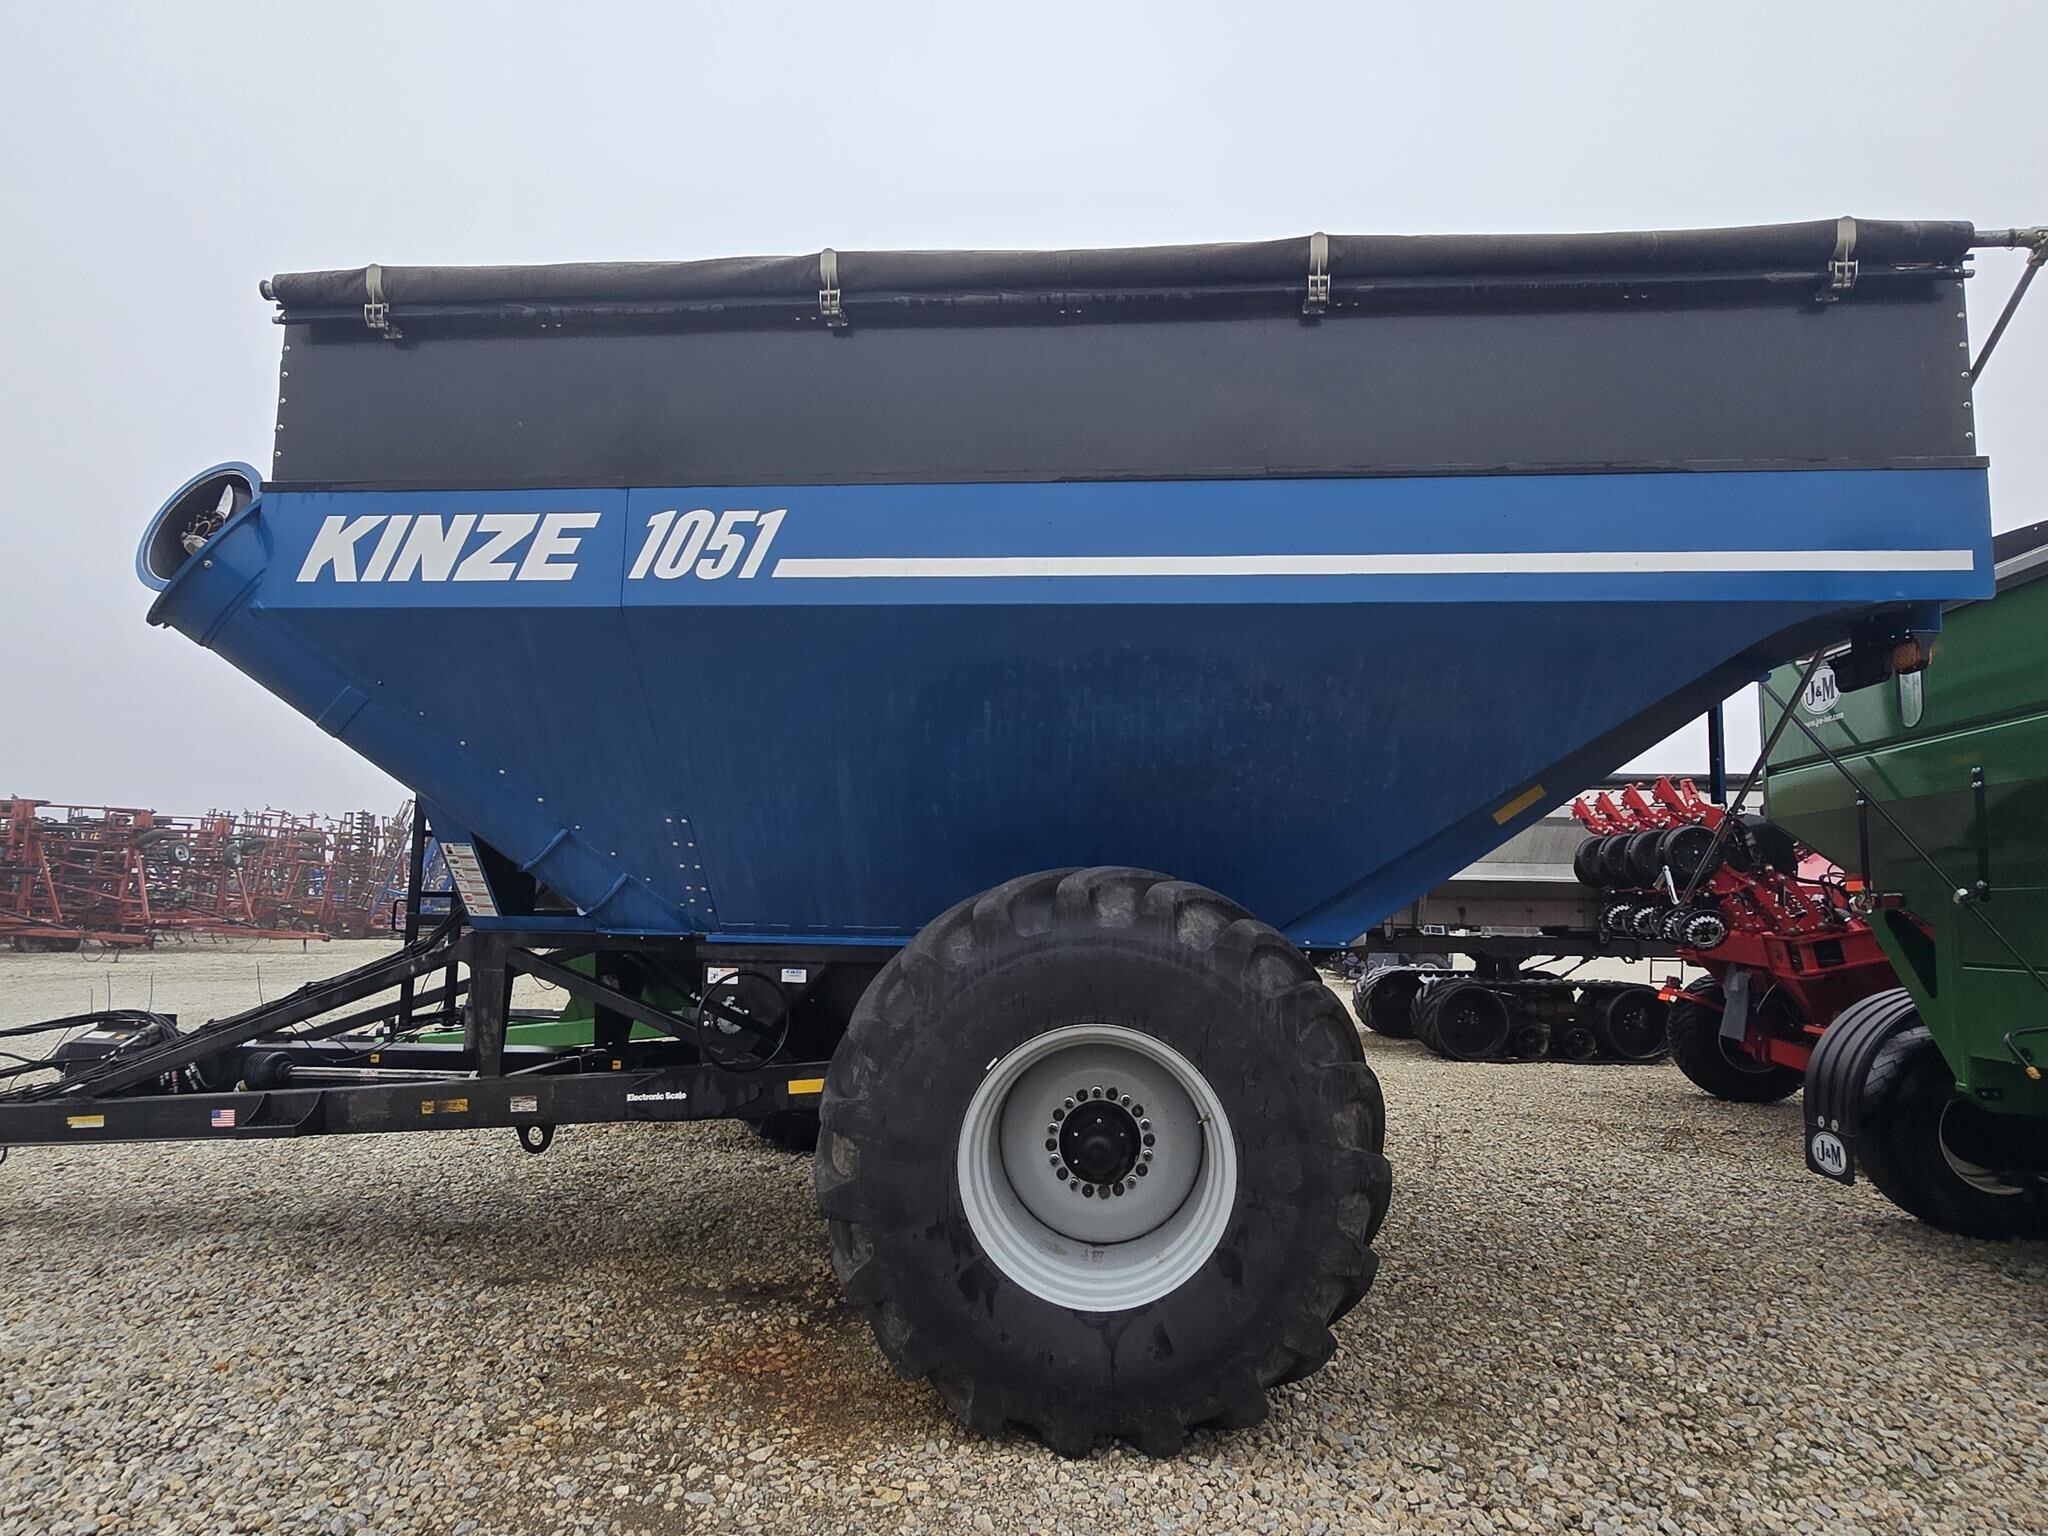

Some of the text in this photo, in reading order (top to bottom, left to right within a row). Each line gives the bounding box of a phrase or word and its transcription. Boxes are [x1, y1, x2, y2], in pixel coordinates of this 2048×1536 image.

[296, 509, 788, 583] KINZE 1051
[1805, 674, 1836, 706] J&M
[626, 1091, 687, 1102] Electronic Scale
[1815, 1139, 1843, 1169] J&M
